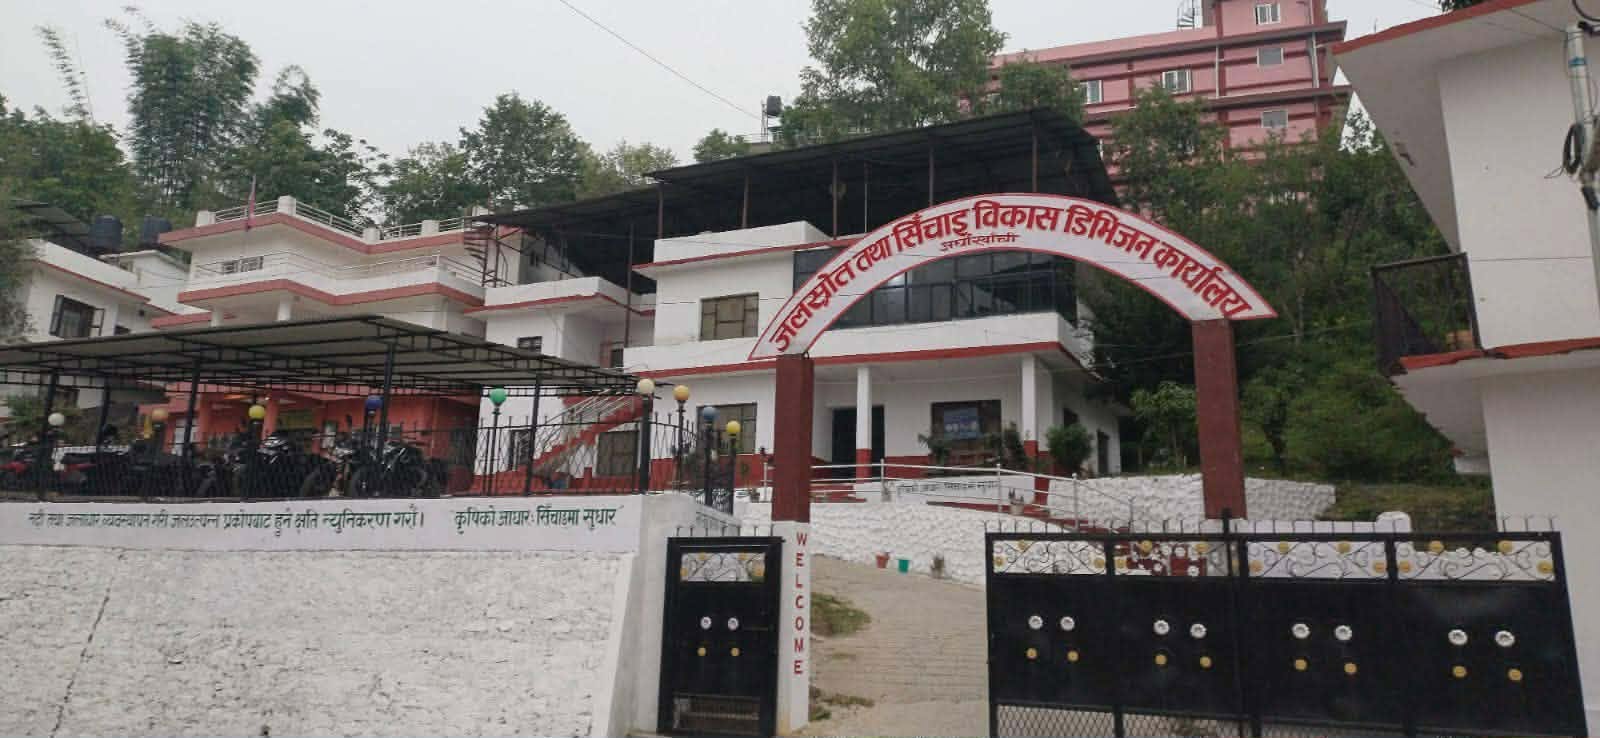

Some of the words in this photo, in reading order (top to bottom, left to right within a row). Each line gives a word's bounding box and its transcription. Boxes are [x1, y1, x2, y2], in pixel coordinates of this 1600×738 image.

[853, 235, 893, 272] तथा
[972, 200, 1066, 231] विकास
[1063, 204, 1161, 261] डिभिजन
[1153, 241, 1253, 318] कार्यालय
[793, 532, 808, 675] WELCOME
